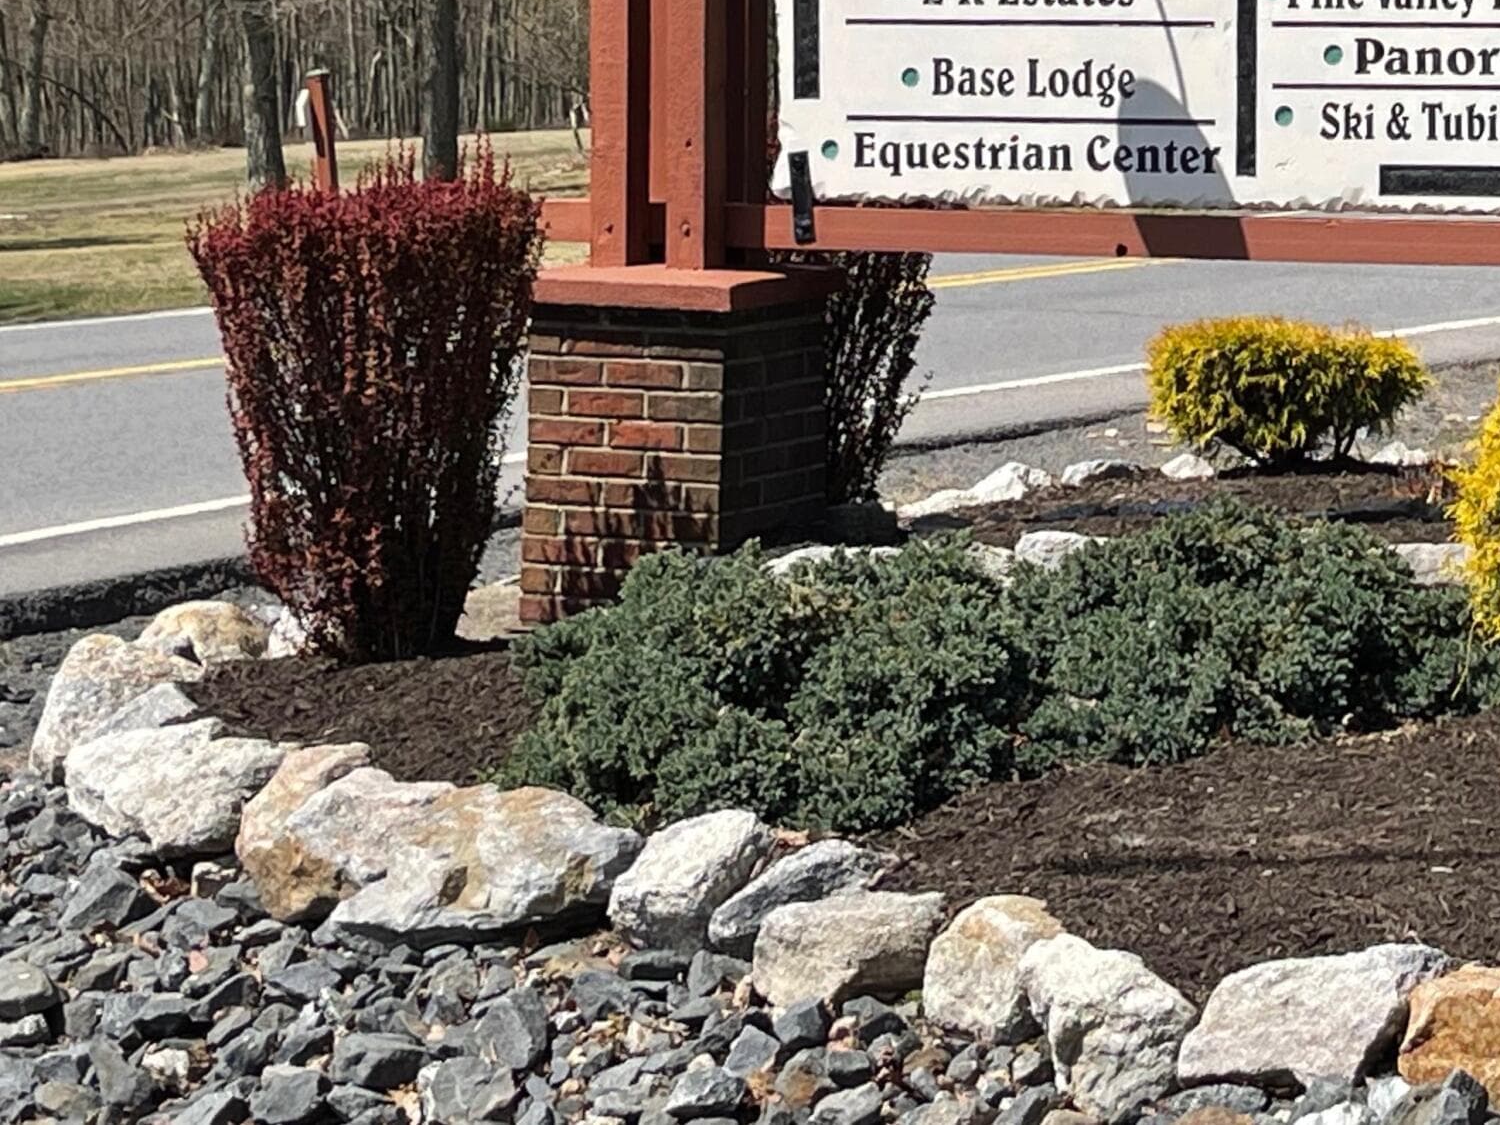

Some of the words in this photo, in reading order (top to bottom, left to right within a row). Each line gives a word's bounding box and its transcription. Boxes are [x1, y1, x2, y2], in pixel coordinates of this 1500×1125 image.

[932, 57, 1016, 97] Base
[1027, 59, 1136, 107] Lodge
[1320, 102, 1375, 141] Ski
[1386, 103, 1412, 141] &
[854, 132, 1073, 176] Equestrian
[1086, 135, 1222, 175] Center
